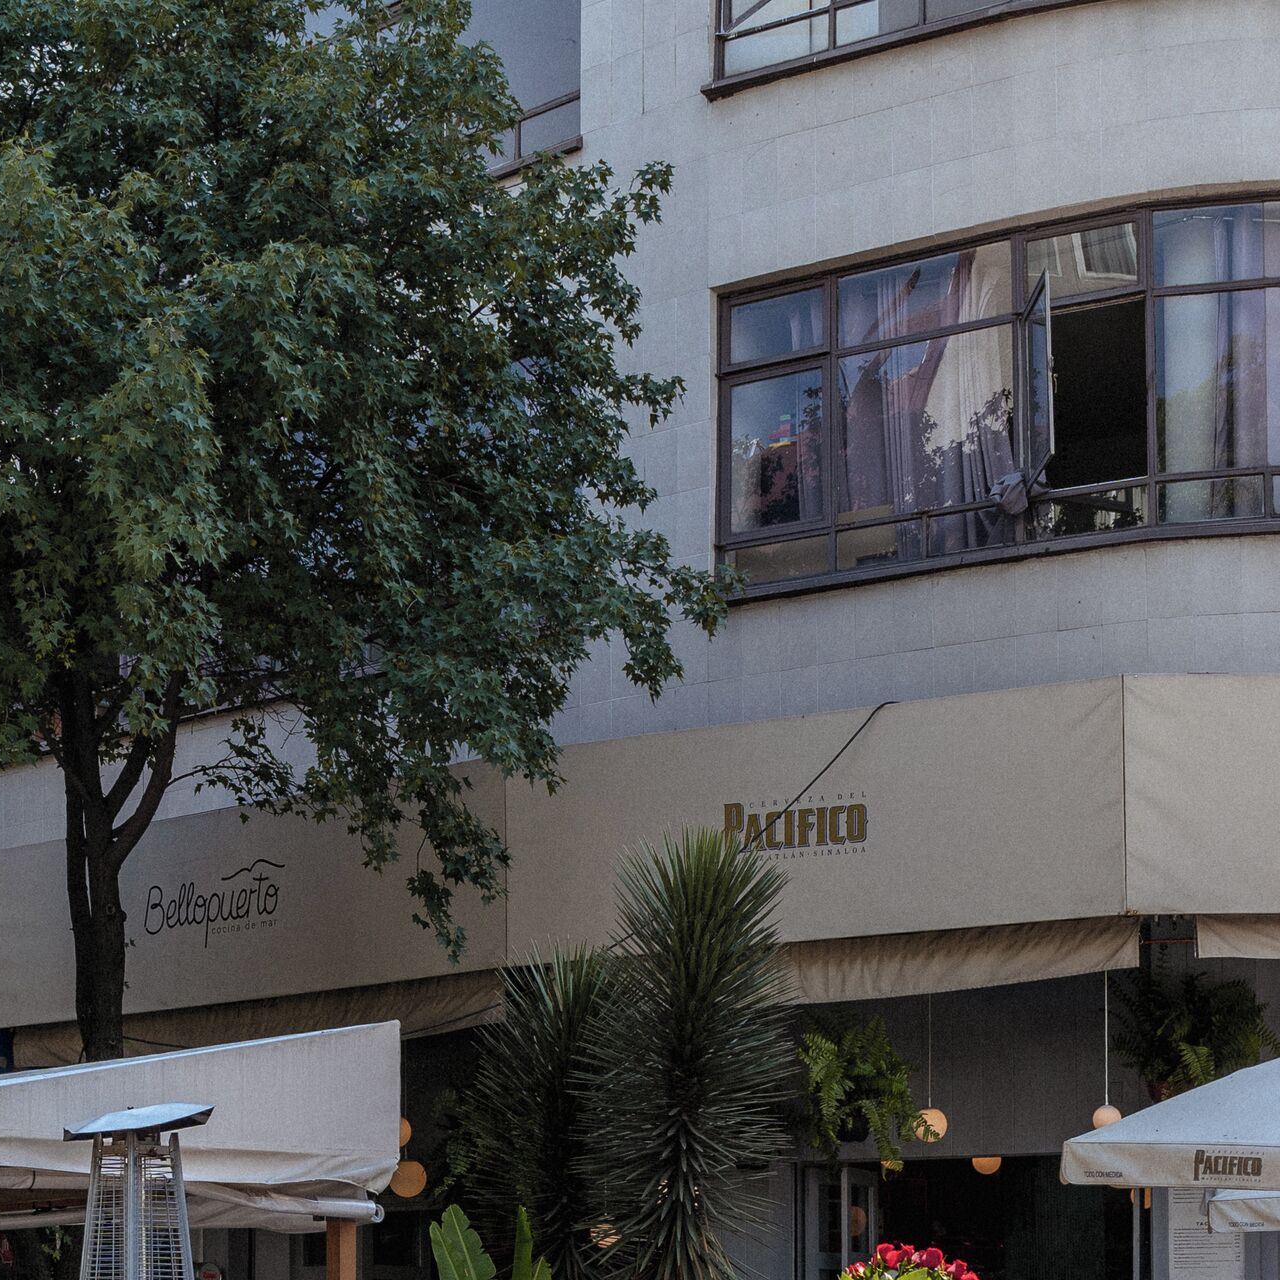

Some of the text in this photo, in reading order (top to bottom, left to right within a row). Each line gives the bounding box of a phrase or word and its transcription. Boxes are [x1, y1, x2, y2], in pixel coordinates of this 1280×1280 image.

[838, 791, 867, 800] DEL
[722, 802, 869, 854] PACIFICO
[144, 871, 280, 949] Bellopuerto
[211, 918, 278, 936] cocina de mar
[1193, 1149, 1263, 1181] PACIFICO
